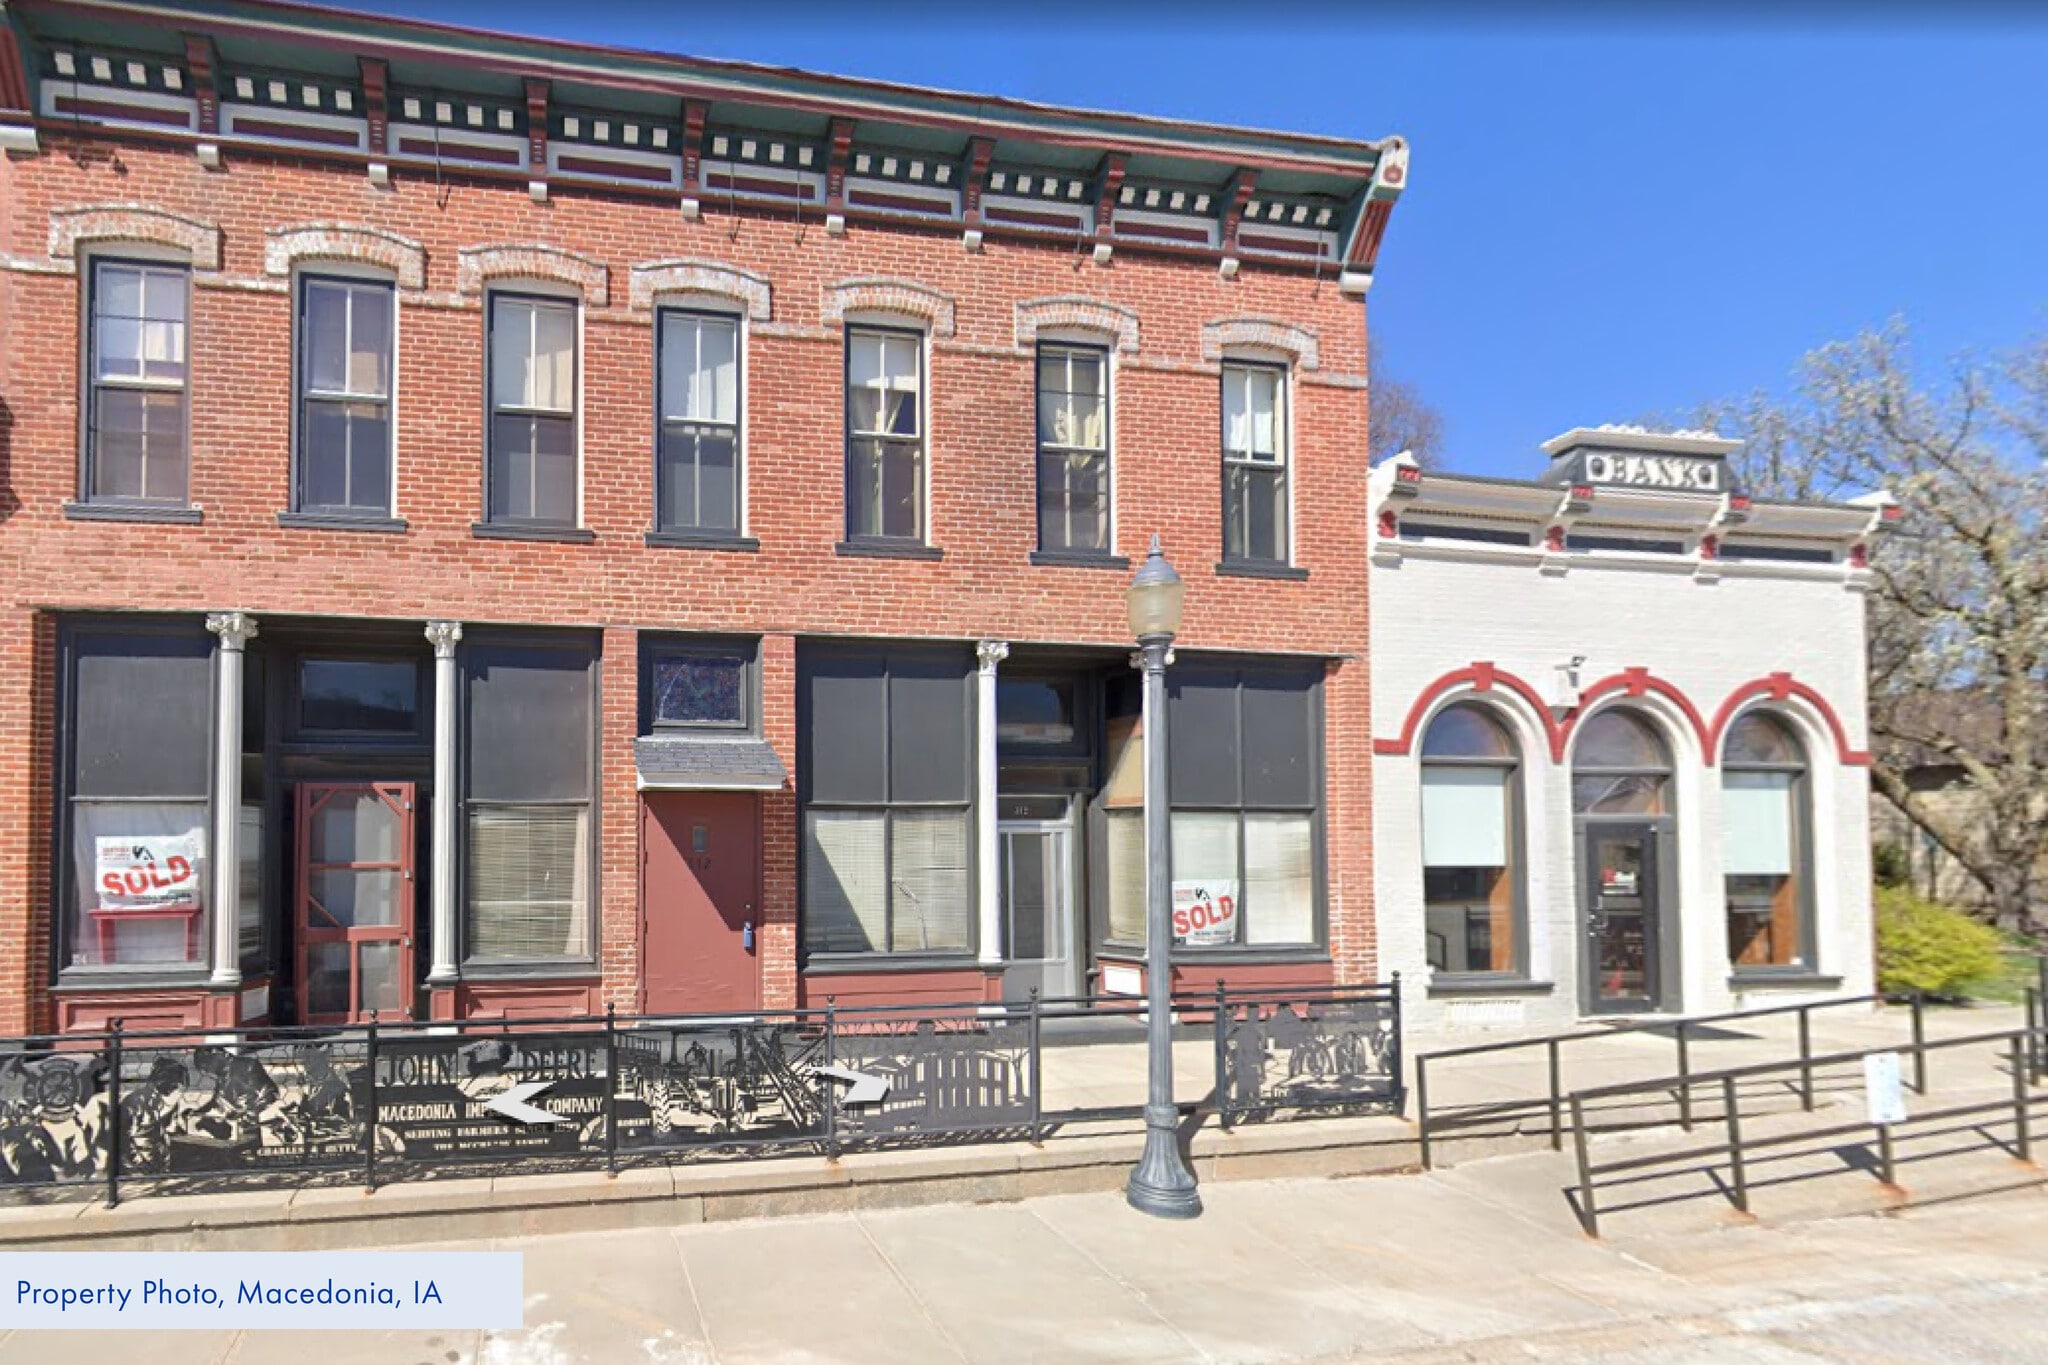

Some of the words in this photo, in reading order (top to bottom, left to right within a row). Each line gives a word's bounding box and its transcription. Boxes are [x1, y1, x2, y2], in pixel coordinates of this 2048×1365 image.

[1611, 453, 1698, 489] BANK
[103, 855, 191, 897] SOLD
[1173, 895, 1233, 935] SOLD
[379, 1053, 457, 1087] JOHN
[519, 1047, 598, 1081] DEERE
[378, 1103, 457, 1123] MACEDONIA
[546, 1096, 604, 1114] COMPANY
